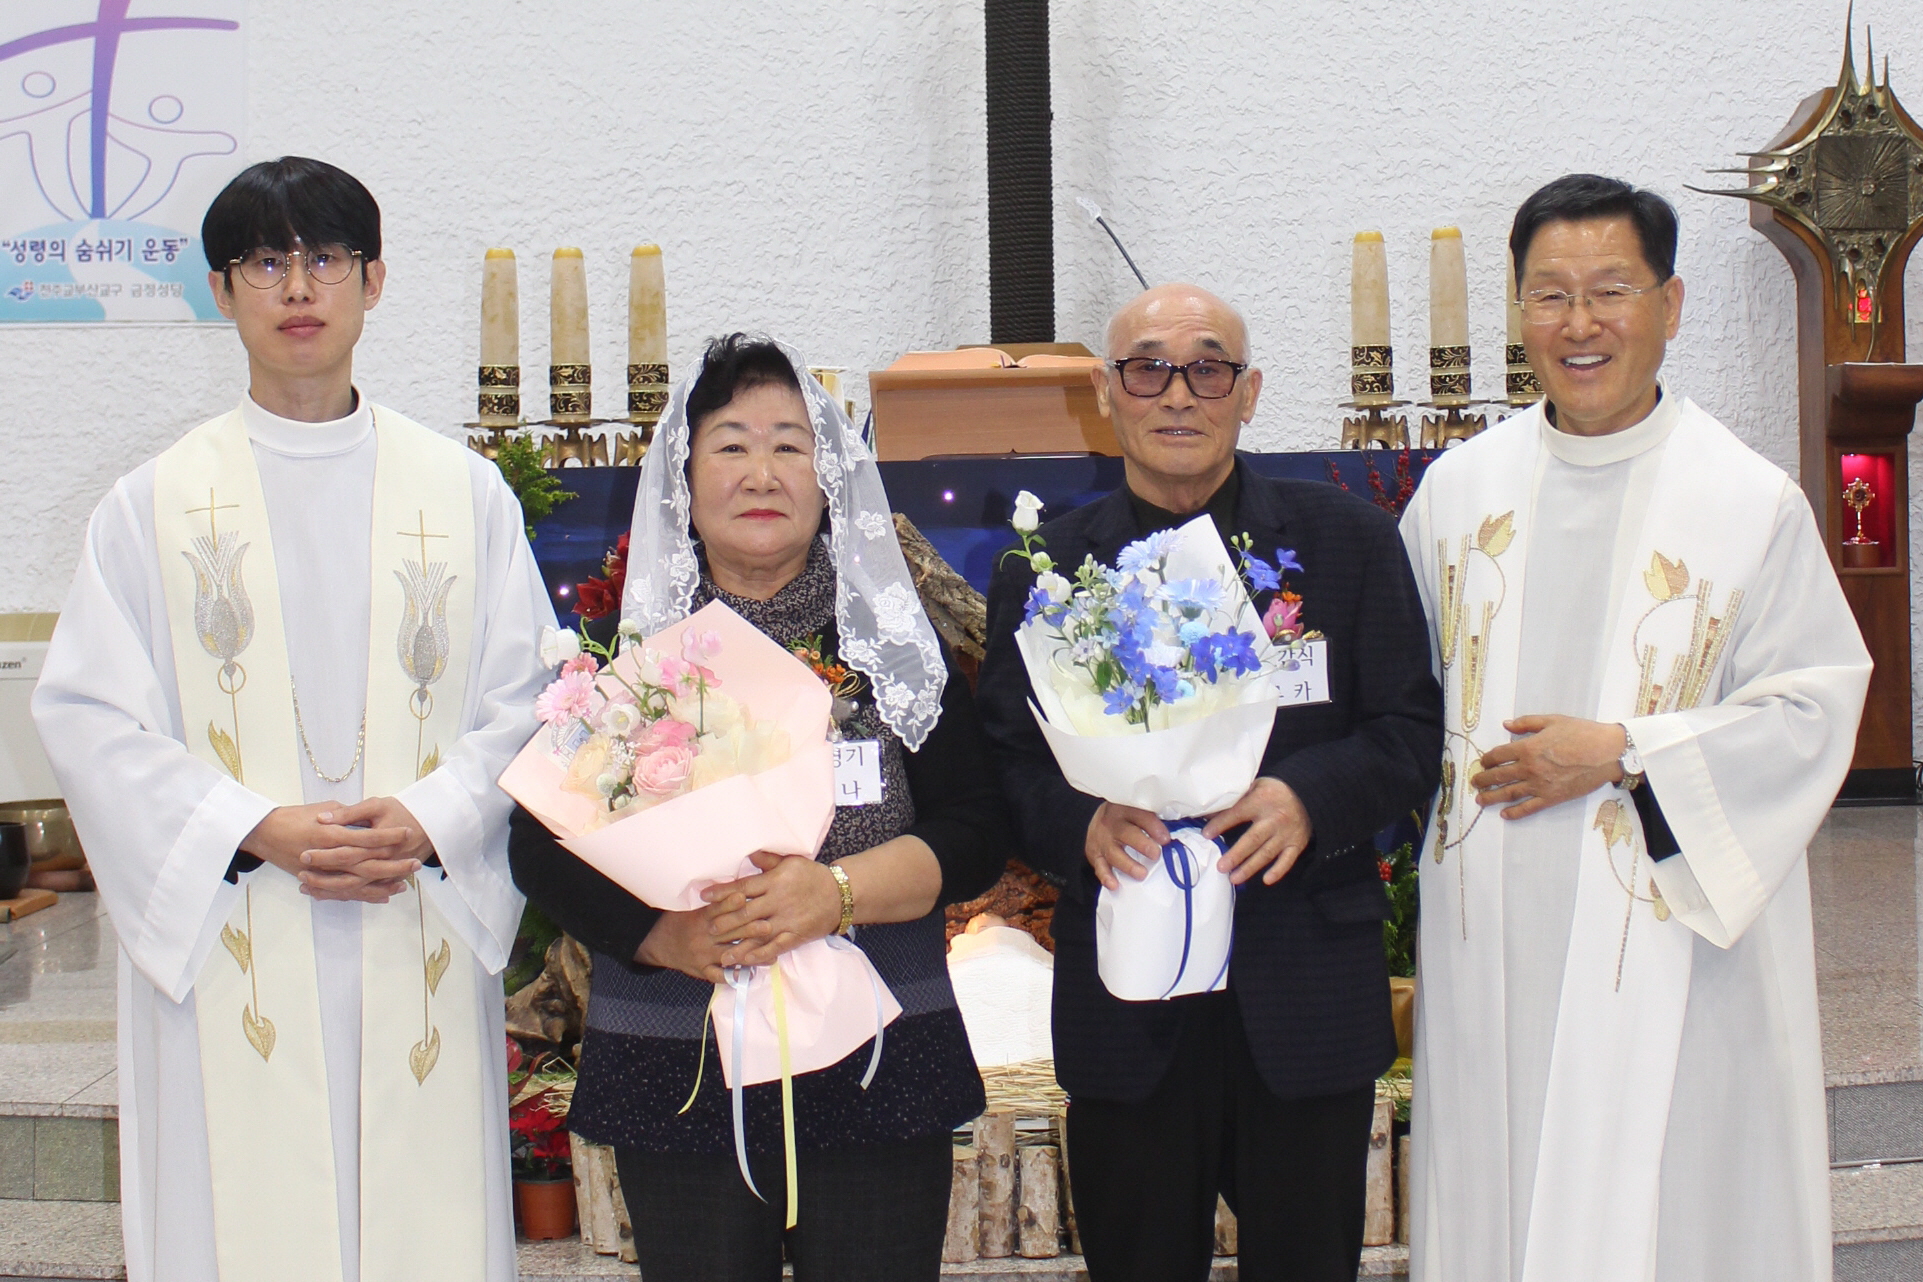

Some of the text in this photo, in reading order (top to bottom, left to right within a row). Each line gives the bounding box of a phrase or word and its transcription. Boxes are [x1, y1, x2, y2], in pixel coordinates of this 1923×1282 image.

[76, 238, 133, 263] 숨쉬기
[142, 238, 188, 262] 운동”
[38, 283, 184, 299] 천주교부산교구 금정성당
